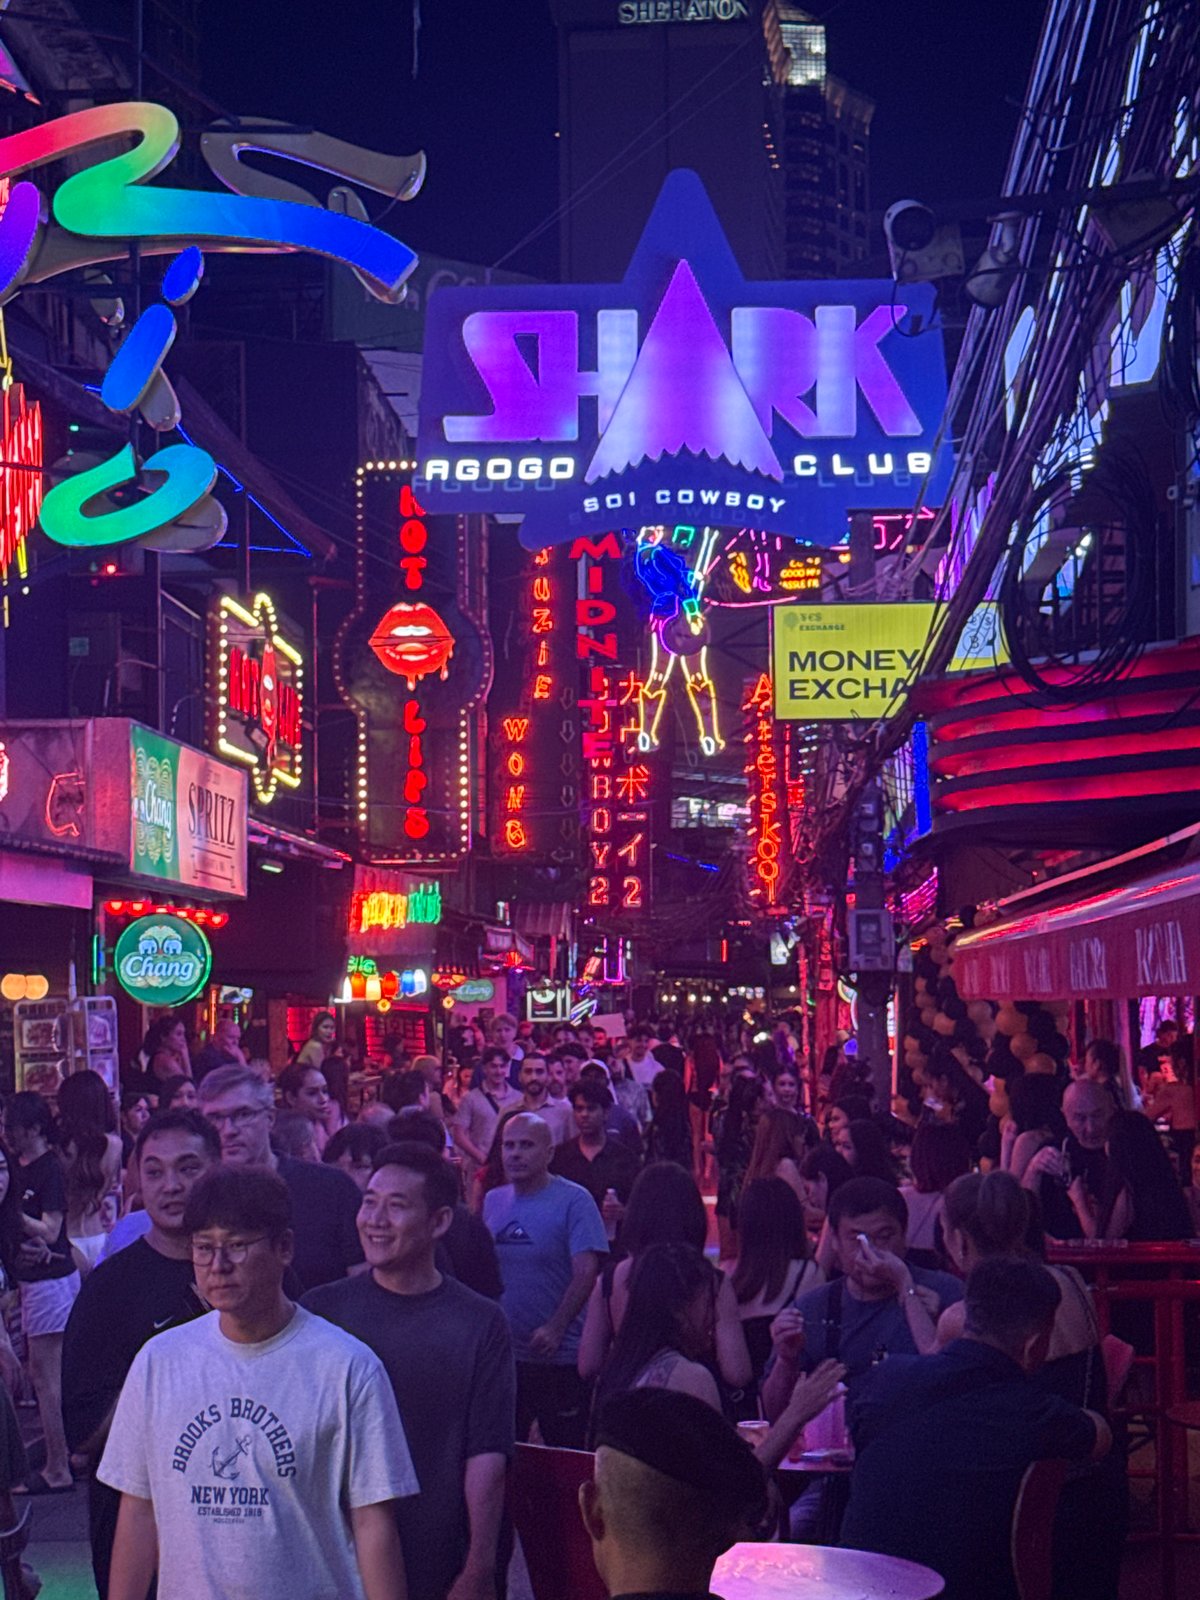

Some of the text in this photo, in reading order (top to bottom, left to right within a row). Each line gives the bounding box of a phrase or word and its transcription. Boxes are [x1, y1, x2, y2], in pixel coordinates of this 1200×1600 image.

[443, 258, 924, 485] SHARK
[425, 457, 575, 481] AGOGO
[794, 452, 932, 476] CLUB
[584, 489, 786, 514] SOI COWBOY
[569, 532, 622, 758] MIDNITE
[789, 649, 921, 672] MONEY
[404, 700, 429, 839] LIPS
[503, 718, 529, 848] WONG
[144, 779, 173, 839] Chang
[188, 781, 237, 847] SPRITZ
[125, 955, 195, 981] Chang
[172, 1397, 297, 1479] BROOKS BROTHERS
[191, 1485, 270, 1505] NEW YORK
[197, 1506, 242, 1517] ESTABLISHED
